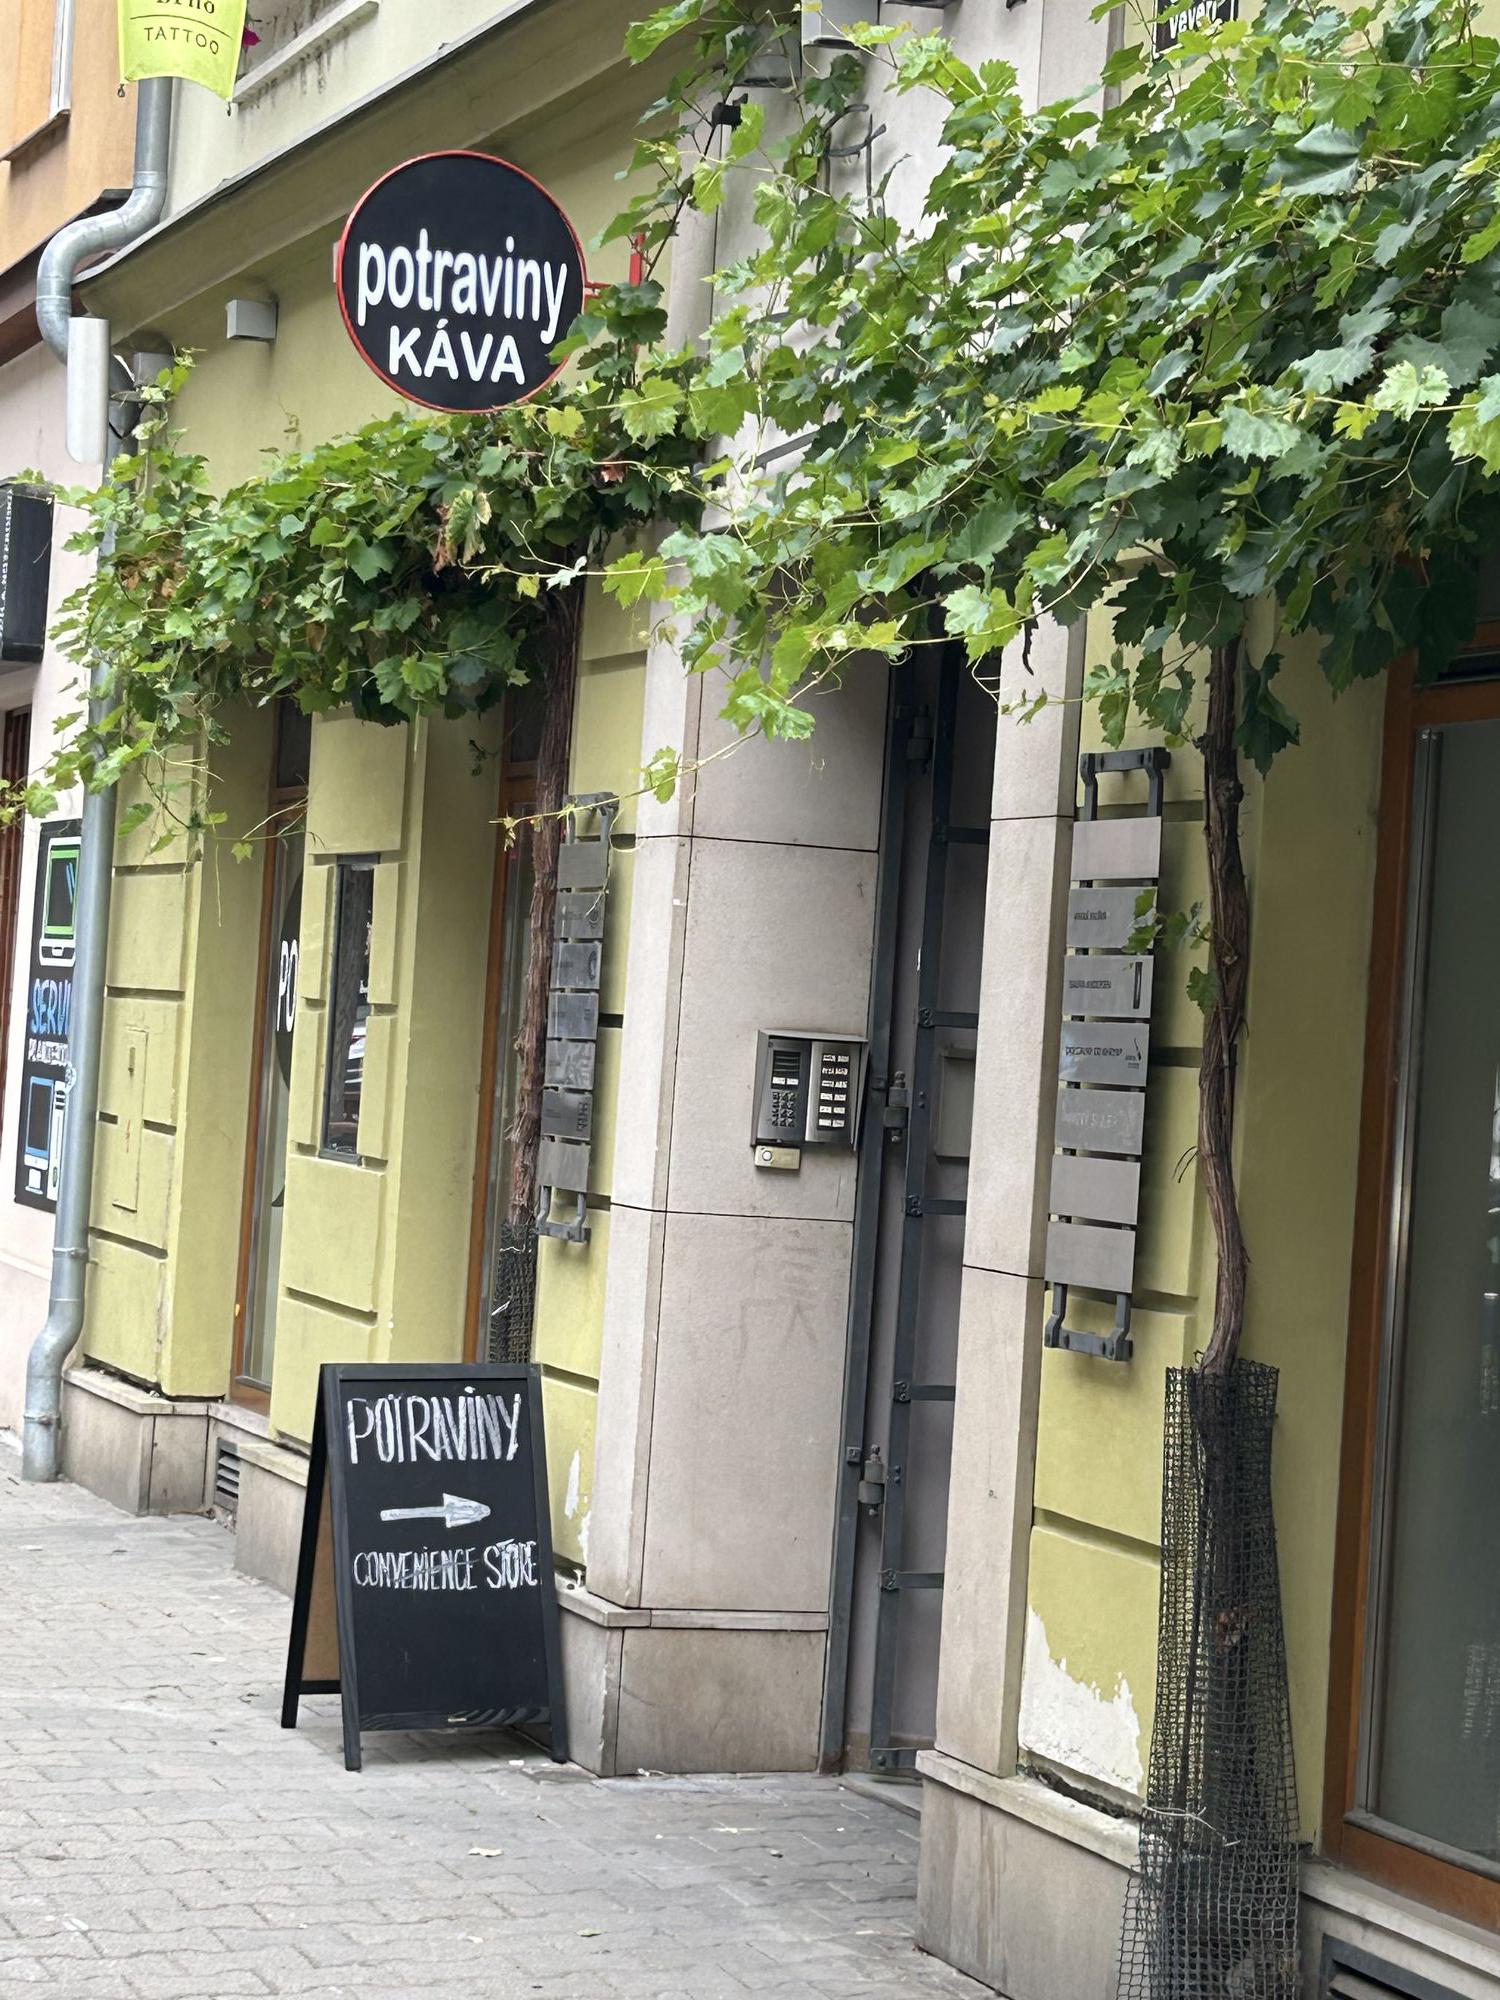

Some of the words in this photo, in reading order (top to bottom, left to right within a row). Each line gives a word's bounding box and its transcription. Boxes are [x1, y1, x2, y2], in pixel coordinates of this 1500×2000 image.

[144, 26, 219, 55] TATTOO
[357, 228, 568, 345] potraviny
[389, 318, 526, 385] KÁVA
[31, 978, 72, 1036] SERVI
[276, 939, 299, 1033] PO
[347, 1386, 521, 1464] POTRAVINY
[353, 1546, 478, 1591] CONVENIENCE
[483, 1538, 539, 1590] STORE
